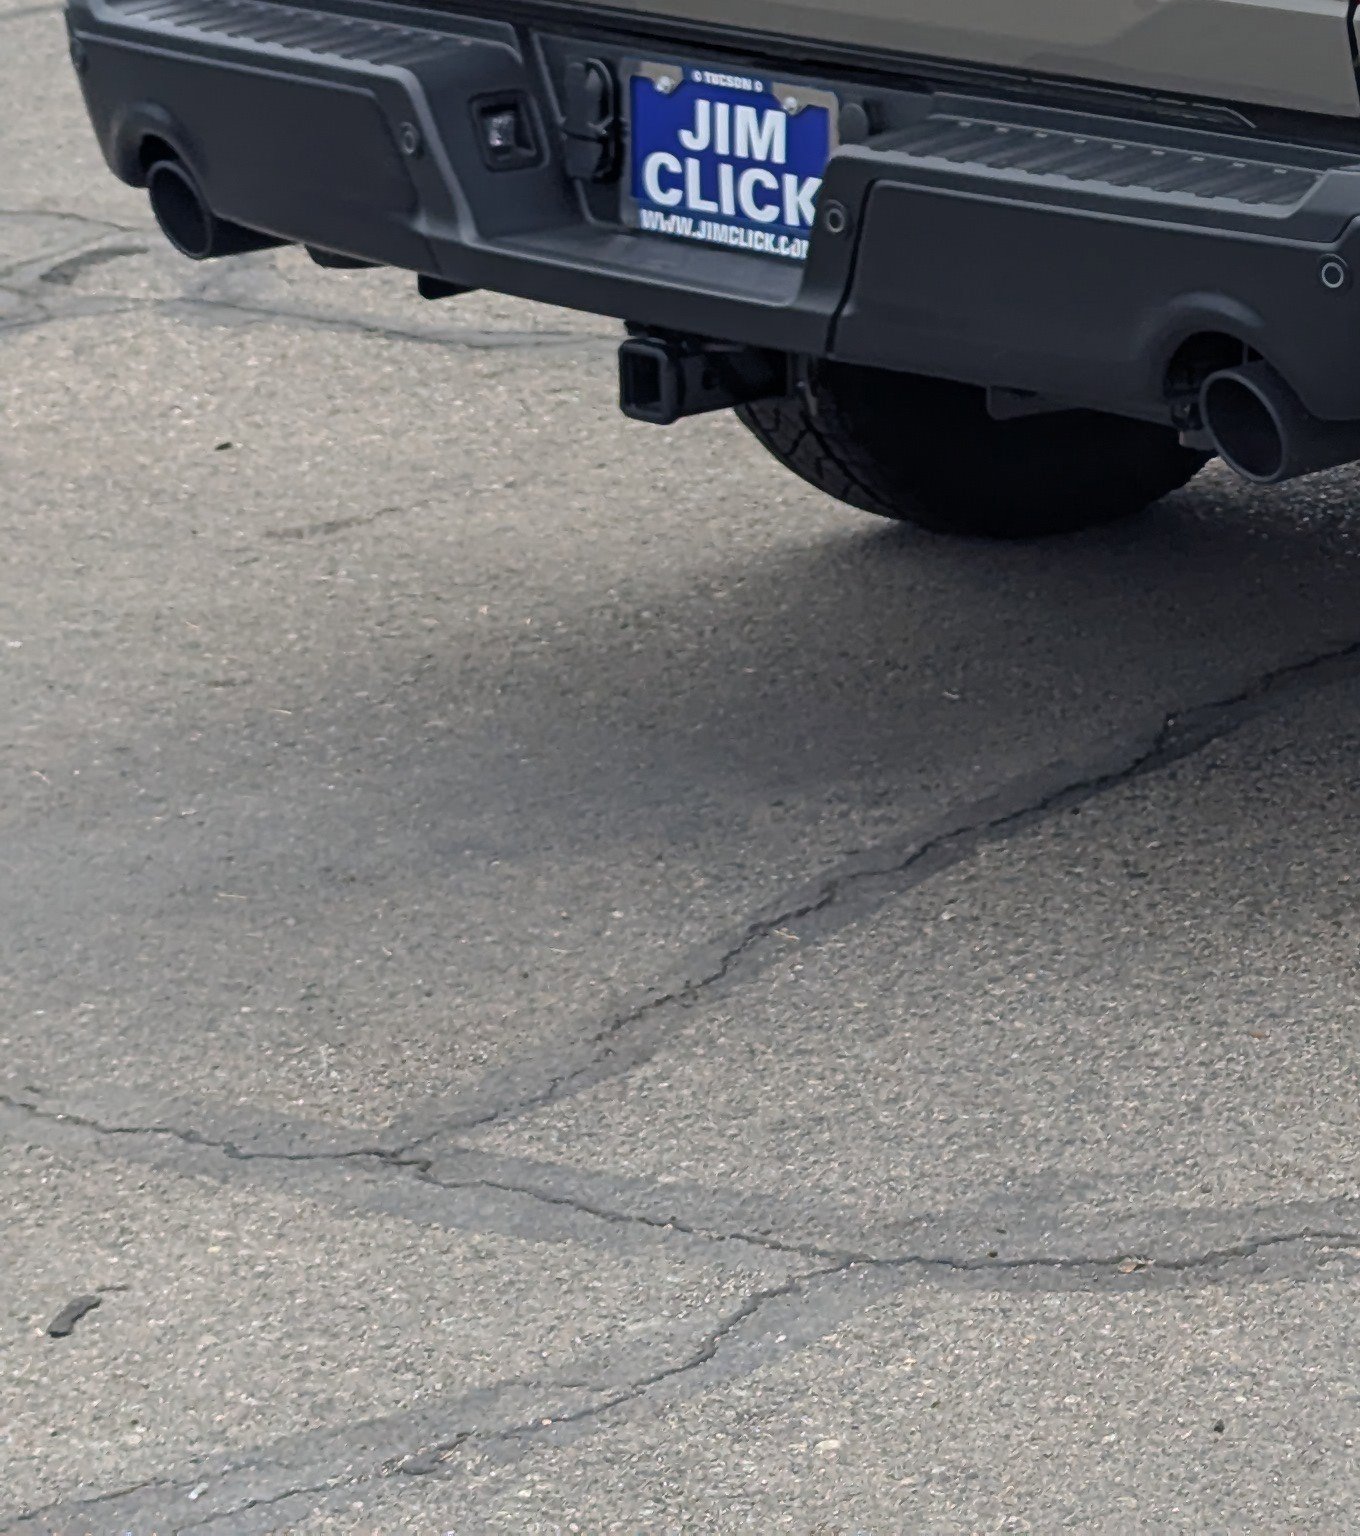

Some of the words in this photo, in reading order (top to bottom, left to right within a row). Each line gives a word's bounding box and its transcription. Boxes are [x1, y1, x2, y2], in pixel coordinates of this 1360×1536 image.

[703, 70, 752, 91] TUCSON
[678, 98, 787, 164] JIM
[643, 151, 823, 227] CLICK
